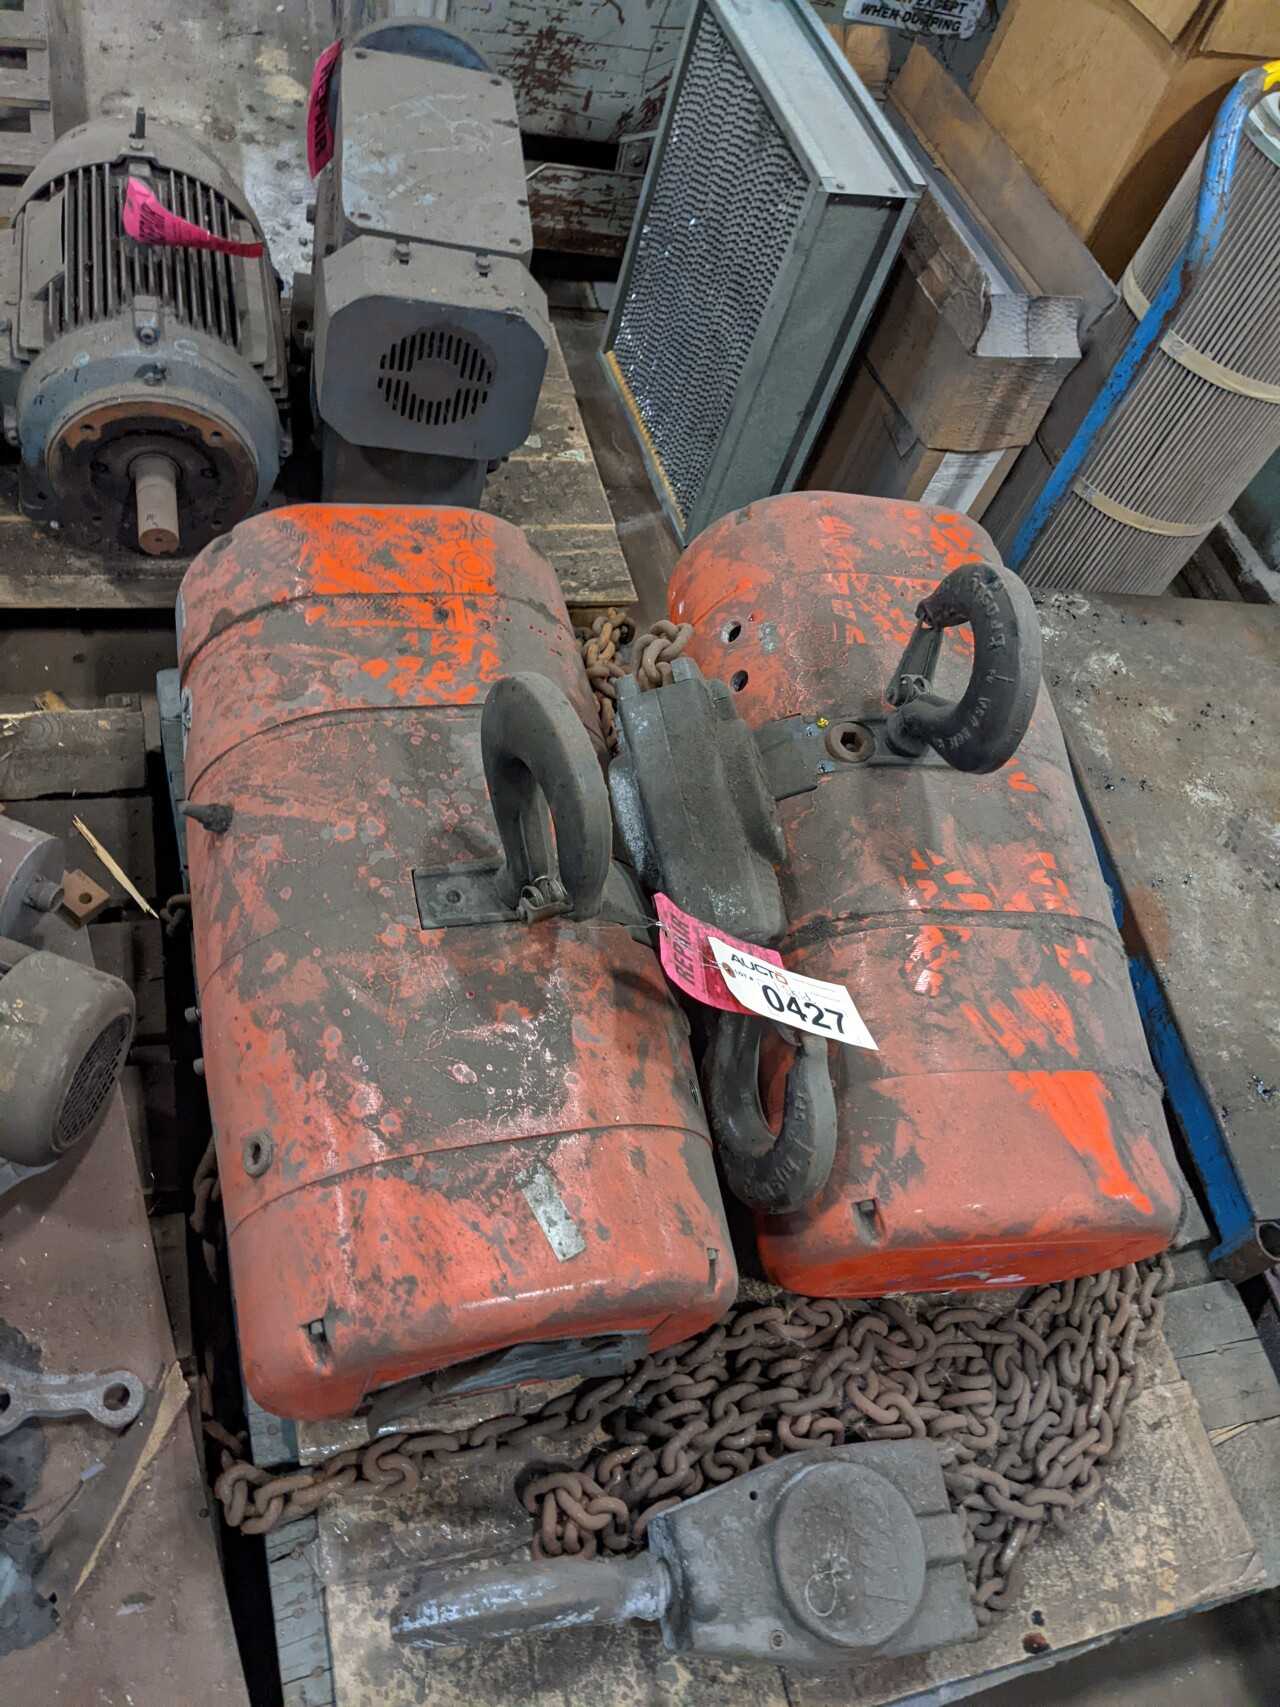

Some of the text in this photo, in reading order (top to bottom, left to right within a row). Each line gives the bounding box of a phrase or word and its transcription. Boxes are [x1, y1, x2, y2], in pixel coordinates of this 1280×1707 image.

[861, 3, 899, 20] WHEN
[670, 912, 697, 986] REPAIR
[731, 954, 789, 985] AUCTO
[761, 984, 845, 1034] 0427
